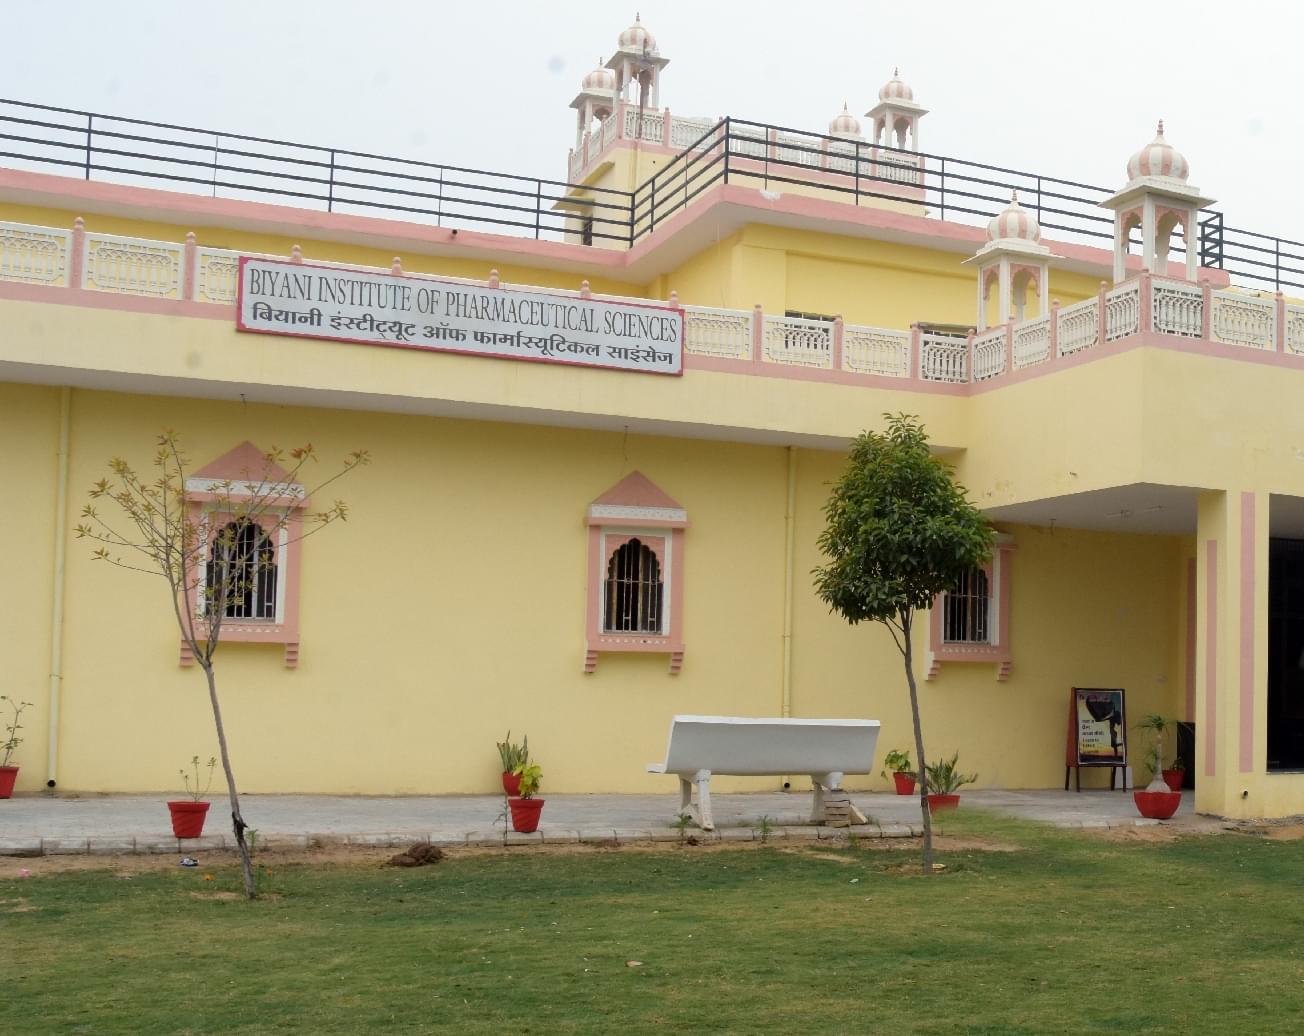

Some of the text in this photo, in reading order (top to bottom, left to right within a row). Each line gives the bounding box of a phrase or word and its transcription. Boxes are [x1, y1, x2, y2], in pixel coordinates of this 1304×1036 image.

[250, 268, 677, 343] BIYANI INSTITUTE OF PHARMACEUTICAL SCIENCES
[252, 301, 322, 327] बियानी
[422, 322, 467, 342] ऑफ
[606, 344, 673, 365] साइंसेज
